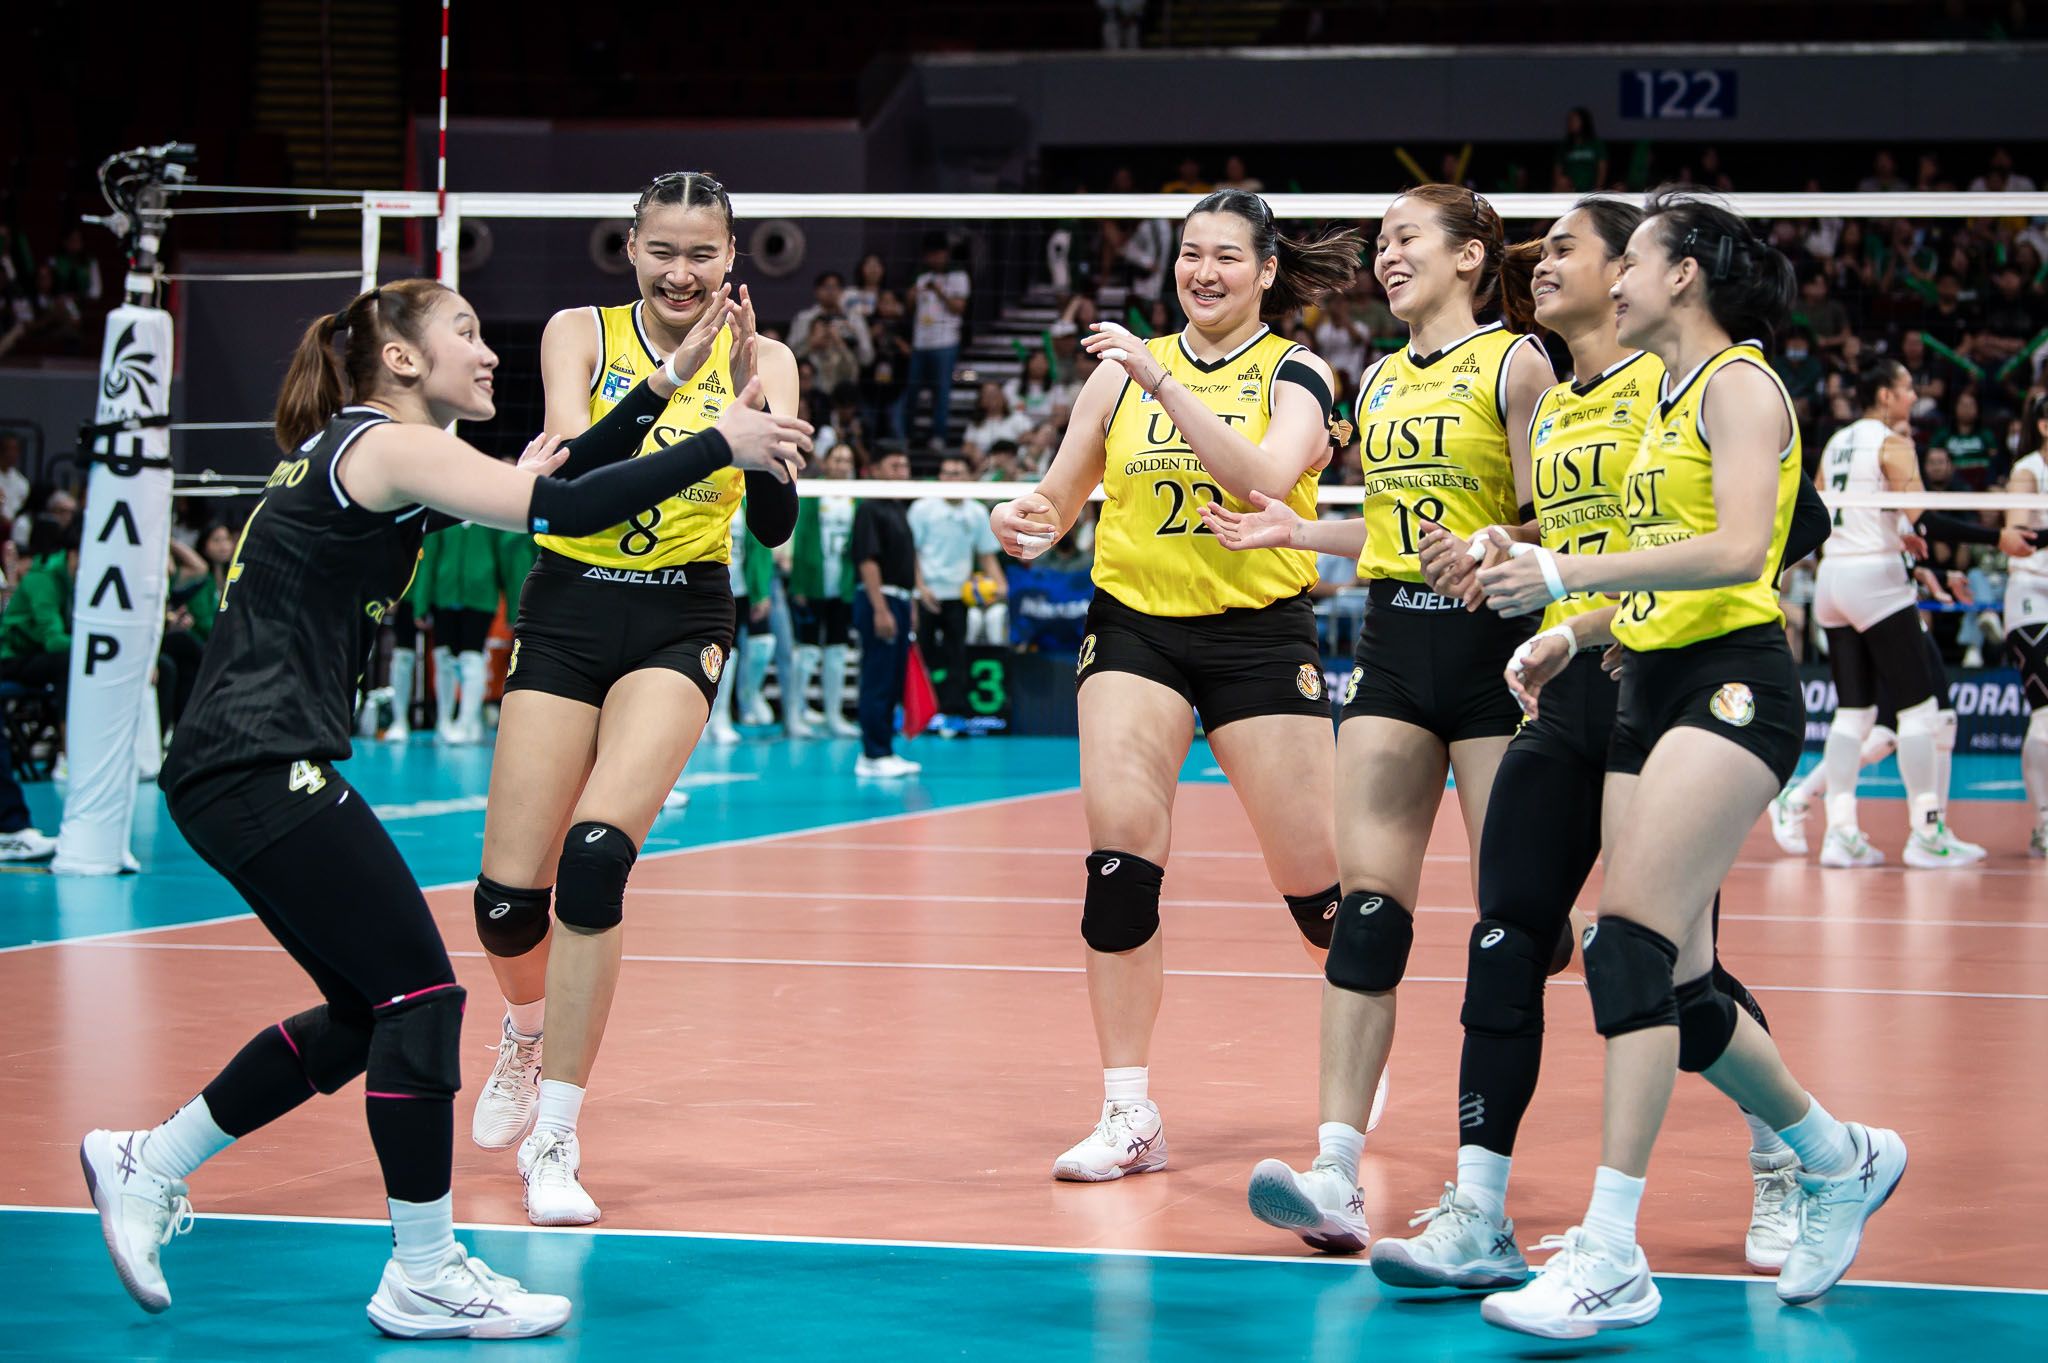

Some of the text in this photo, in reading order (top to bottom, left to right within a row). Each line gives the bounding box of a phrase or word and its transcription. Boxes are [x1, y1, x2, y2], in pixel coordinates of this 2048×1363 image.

[1636, 70, 1721, 117] 122
[697, 382, 727, 395] DELTA
[1452, 365, 1480, 375] DELTA
[1611, 391, 1640, 399] DELTA
[1365, 415, 1460, 463] UST
[1125, 457, 1180, 476] GOLDEN
[1535, 442, 1617, 500] UST
[619, 505, 662, 556] 8
[1154, 480, 1224, 536] 22
[968, 659, 1006, 714] 3
[289, 759, 327, 795] 4
